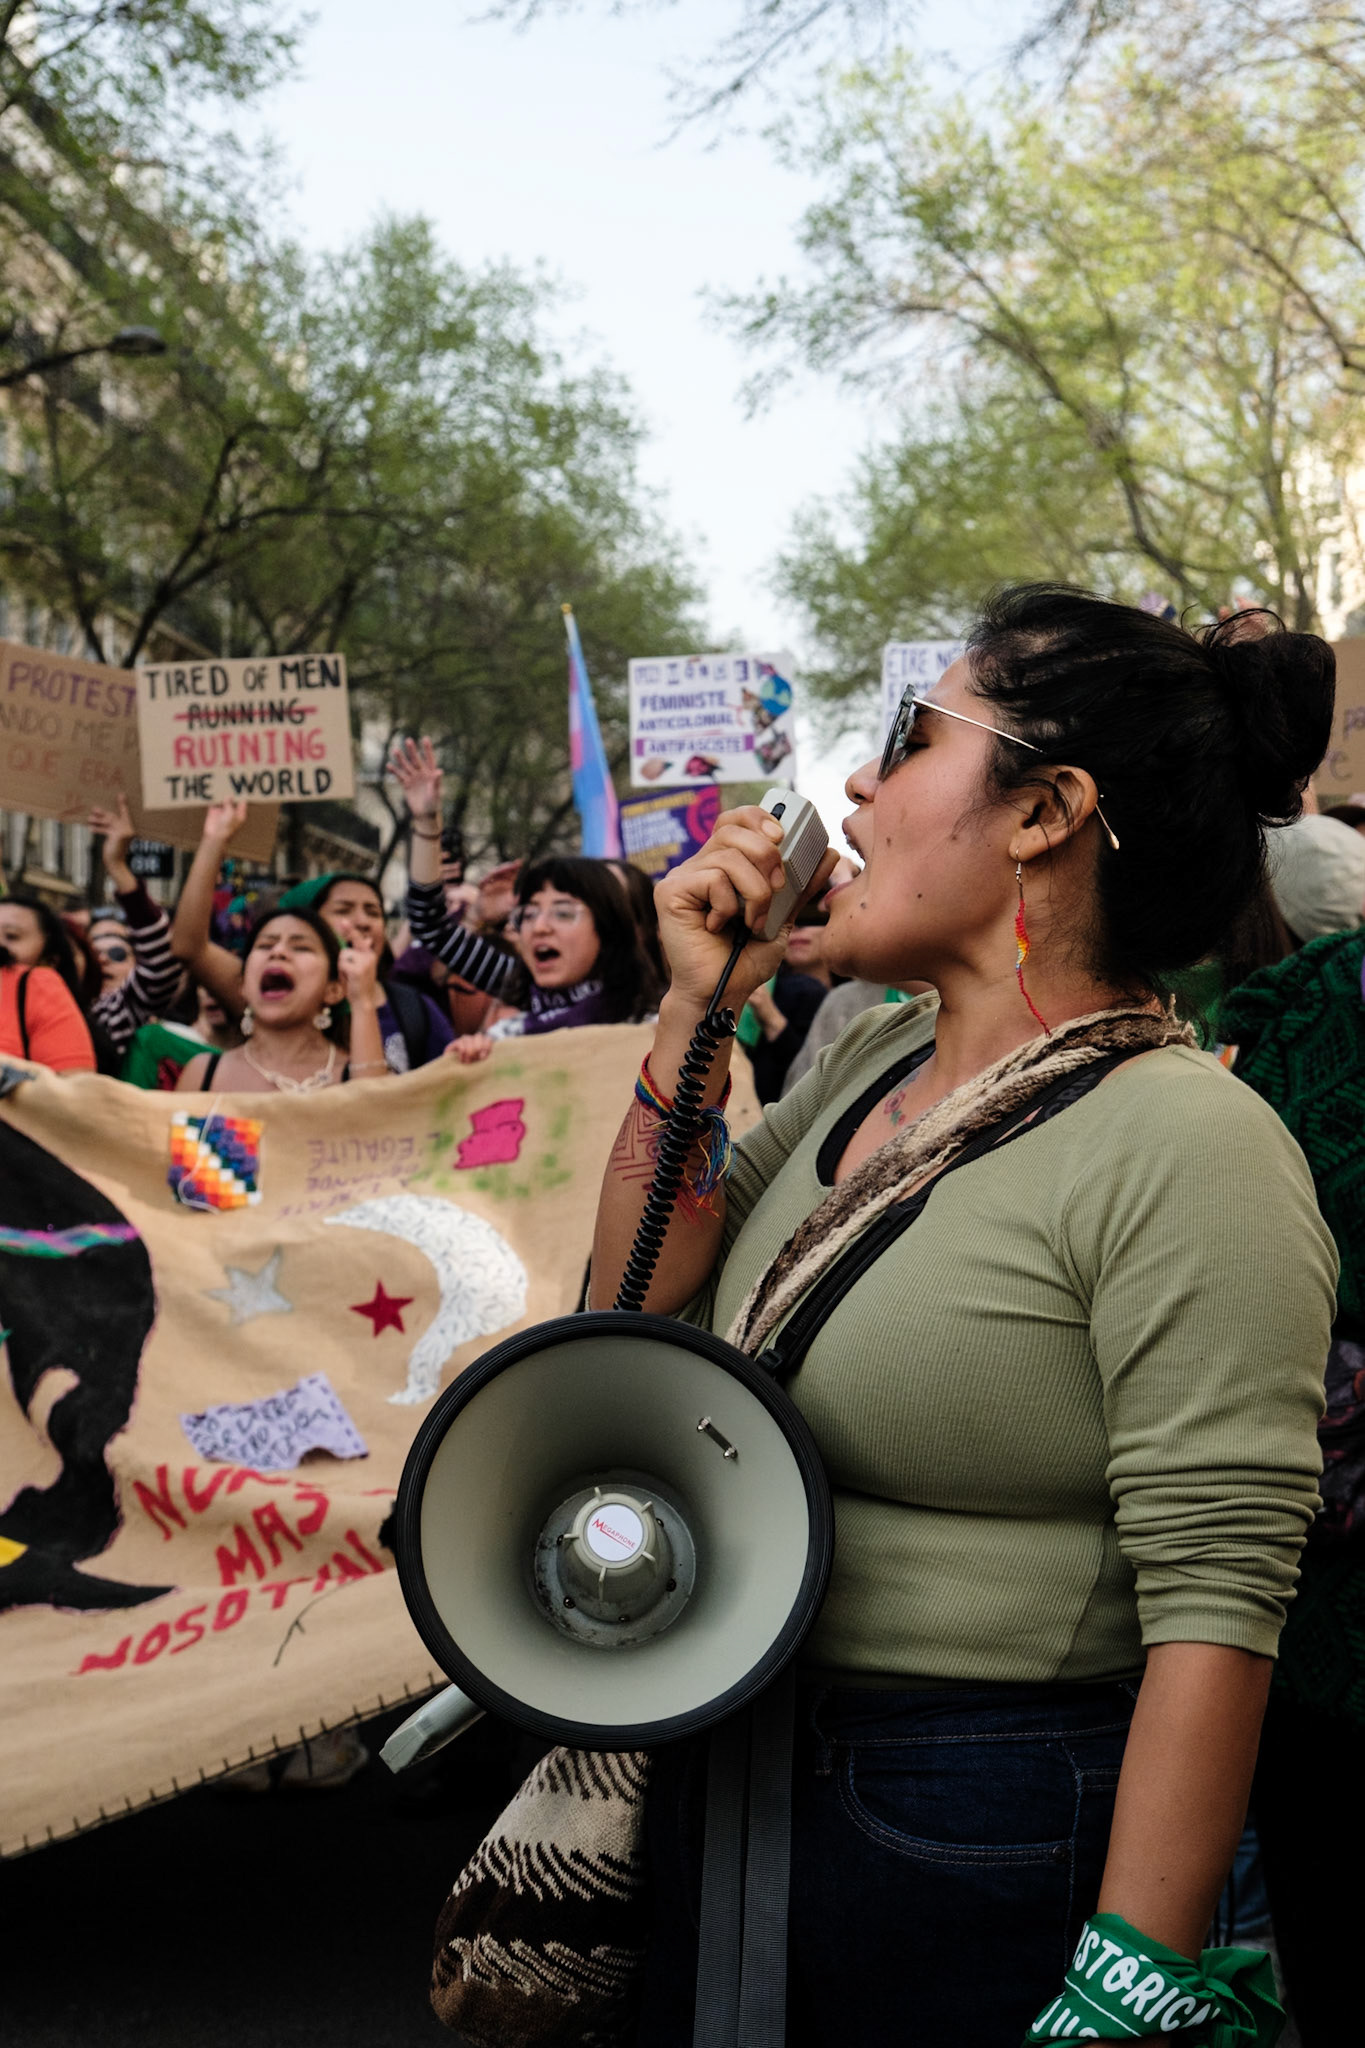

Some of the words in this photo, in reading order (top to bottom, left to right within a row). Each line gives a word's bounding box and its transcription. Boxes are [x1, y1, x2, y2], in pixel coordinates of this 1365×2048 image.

[146, 665, 229, 699] TIRED
[243, 665, 267, 691] OF
[280, 657, 341, 691] MEN
[187, 698, 306, 731] RUNNING
[174, 728, 326, 768] RUINING
[165, 774, 213, 800] THE
[229, 767, 332, 797] WORLD
[592, 1519, 636, 1548] MEGAPHONE
